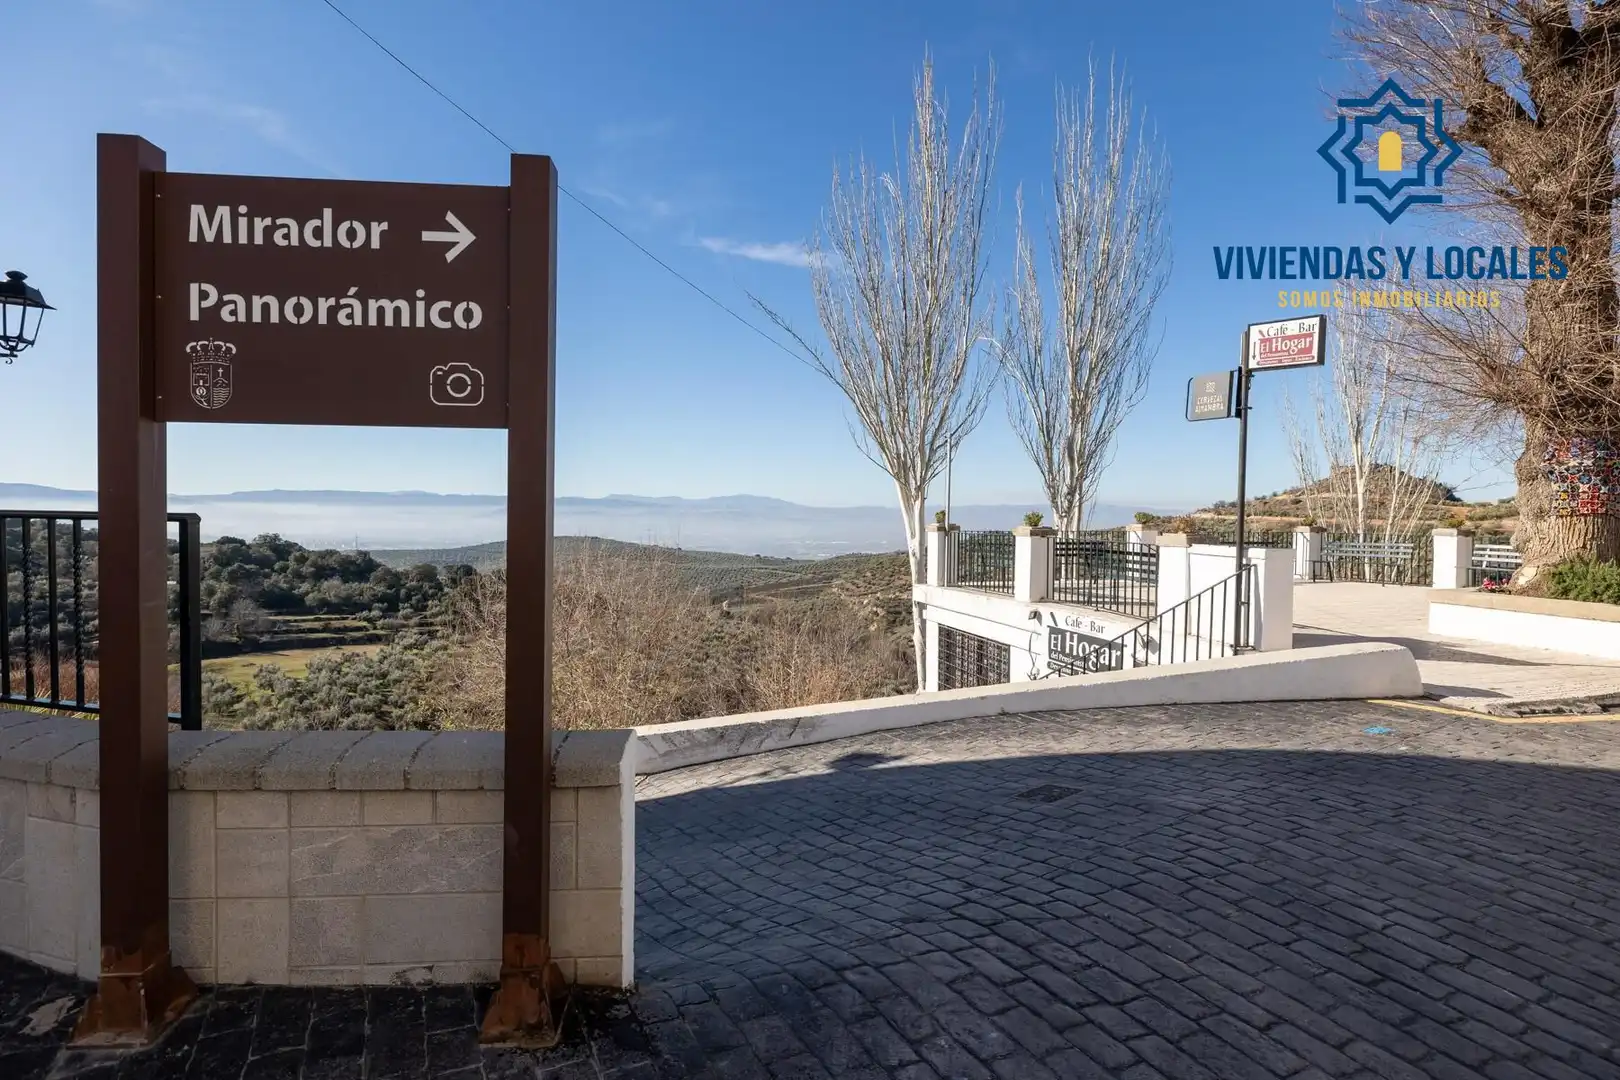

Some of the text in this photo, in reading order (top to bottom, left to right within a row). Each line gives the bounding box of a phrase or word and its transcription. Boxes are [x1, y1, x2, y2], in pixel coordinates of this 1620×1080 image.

[188, 204, 389, 249] Mirador
[189, 282, 483, 330] Panorámico
[1298, 321, 1317, 333] Bar
[1260, 336, 1313, 355] El Hogar
[1090, 620, 1106, 634] Bar
[1050, 633, 1062, 651] El
[1065, 631, 1121, 671] Hogar
